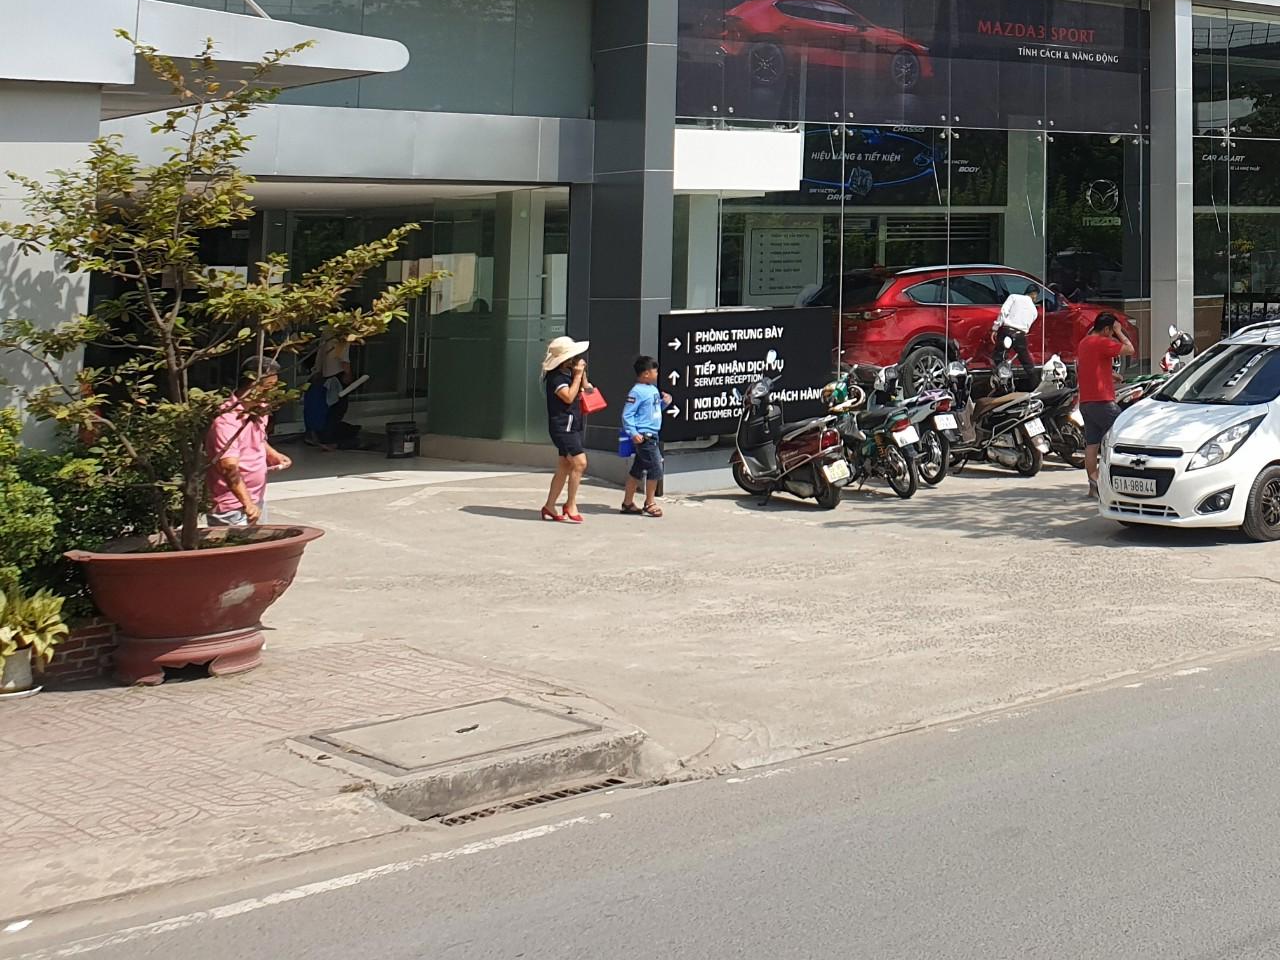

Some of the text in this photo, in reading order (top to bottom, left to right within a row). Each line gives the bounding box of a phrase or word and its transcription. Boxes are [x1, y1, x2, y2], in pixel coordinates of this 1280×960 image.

[977, 20, 1096, 43] MAZDA3 SPORT
[1018, 46, 1119, 64] TÍNH CÁCH & NĂNG ĐỘNG
[811, 150, 831, 161] HIỆU
[695, 328, 730, 343] PHÒNG
[764, 325, 784, 339] BÀY
[695, 342, 738, 354] SHOWROOM
[694, 359, 785, 376] TIẾP NHẬN DỊCH VỤ
[694, 373, 764, 388] SERVICE RECEPTION
[694, 397, 712, 409] NƠI
[713, 392, 728, 407] ĐỖ
[694, 409, 732, 421] CUSTOMER
